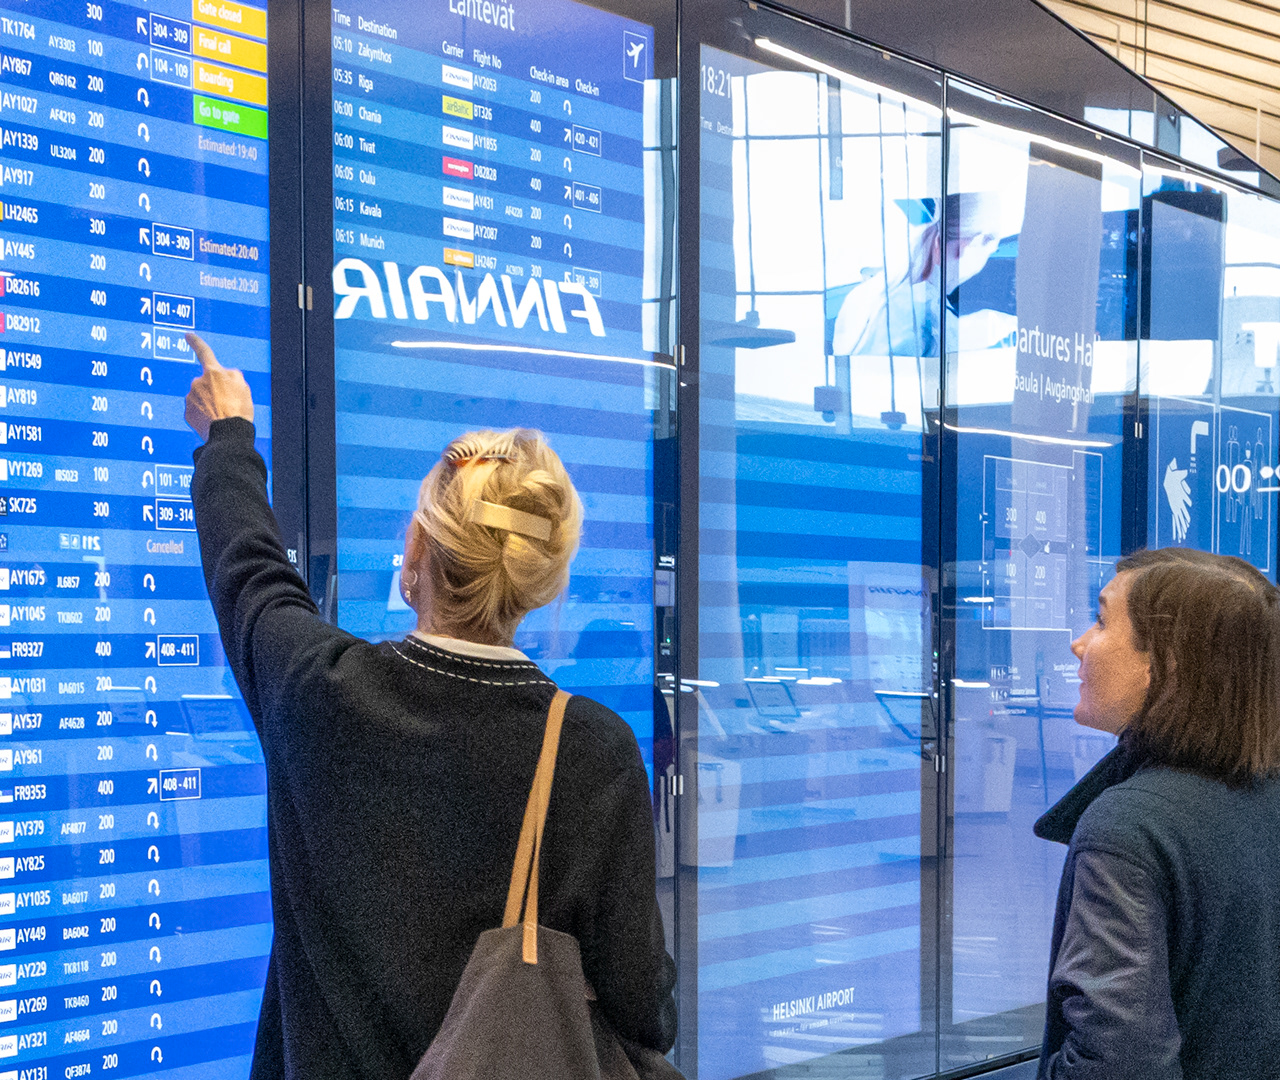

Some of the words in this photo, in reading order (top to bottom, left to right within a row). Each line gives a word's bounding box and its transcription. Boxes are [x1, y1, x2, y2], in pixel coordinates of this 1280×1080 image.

[221, 4, 242, 23] closed
[198, 32, 216, 50] Final
[218, 37, 232, 55] call
[333, 9, 351, 26] Time
[358, 16, 397, 39] Destination
[442, 41, 464, 57] Carrier
[474, 49, 490, 66] Flight
[530, 66, 554, 83] Check-in
[556, 76, 568, 88] area
[576, 79, 599, 95] Check-in
[334, 36, 352, 53] 05:10
[358, 42, 392, 63] Zakynthos
[0, 17, 36, 40] TK1764
[199, 67, 234, 92] Boarding
[2, 55, 31, 75] AY867
[199, 102, 210, 117] Go
[222, 109, 240, 126] gate
[359, 74, 373, 92] Riga
[701, 65, 731, 99] 18:21
[359, 107, 381, 123] Chania
[359, 138, 375, 153] Tivat
[4, 167, 33, 185] AY917
[360, 170, 375, 185] Oulu
[360, 202, 381, 217] Kavala
[336, 229, 354, 244] 06:15
[360, 233, 384, 249] Munich
[5, 241, 34, 259] AY445
[7, 351, 41, 369] AY1549
[8, 461, 43, 477] VY1269
[146, 538, 184, 554] Cancelled
[11, 606, 45, 621] AY1045
[12, 642, 43, 657] FR9327
[14, 784, 46, 800] FR9353
[15, 855, 44, 872] AY825
[17, 926, 46, 943] AY449
[773, 997, 814, 1021] HELSINKI
[817, 988, 854, 1010] AIRPORT
[18, 1031, 46, 1049] AY321
